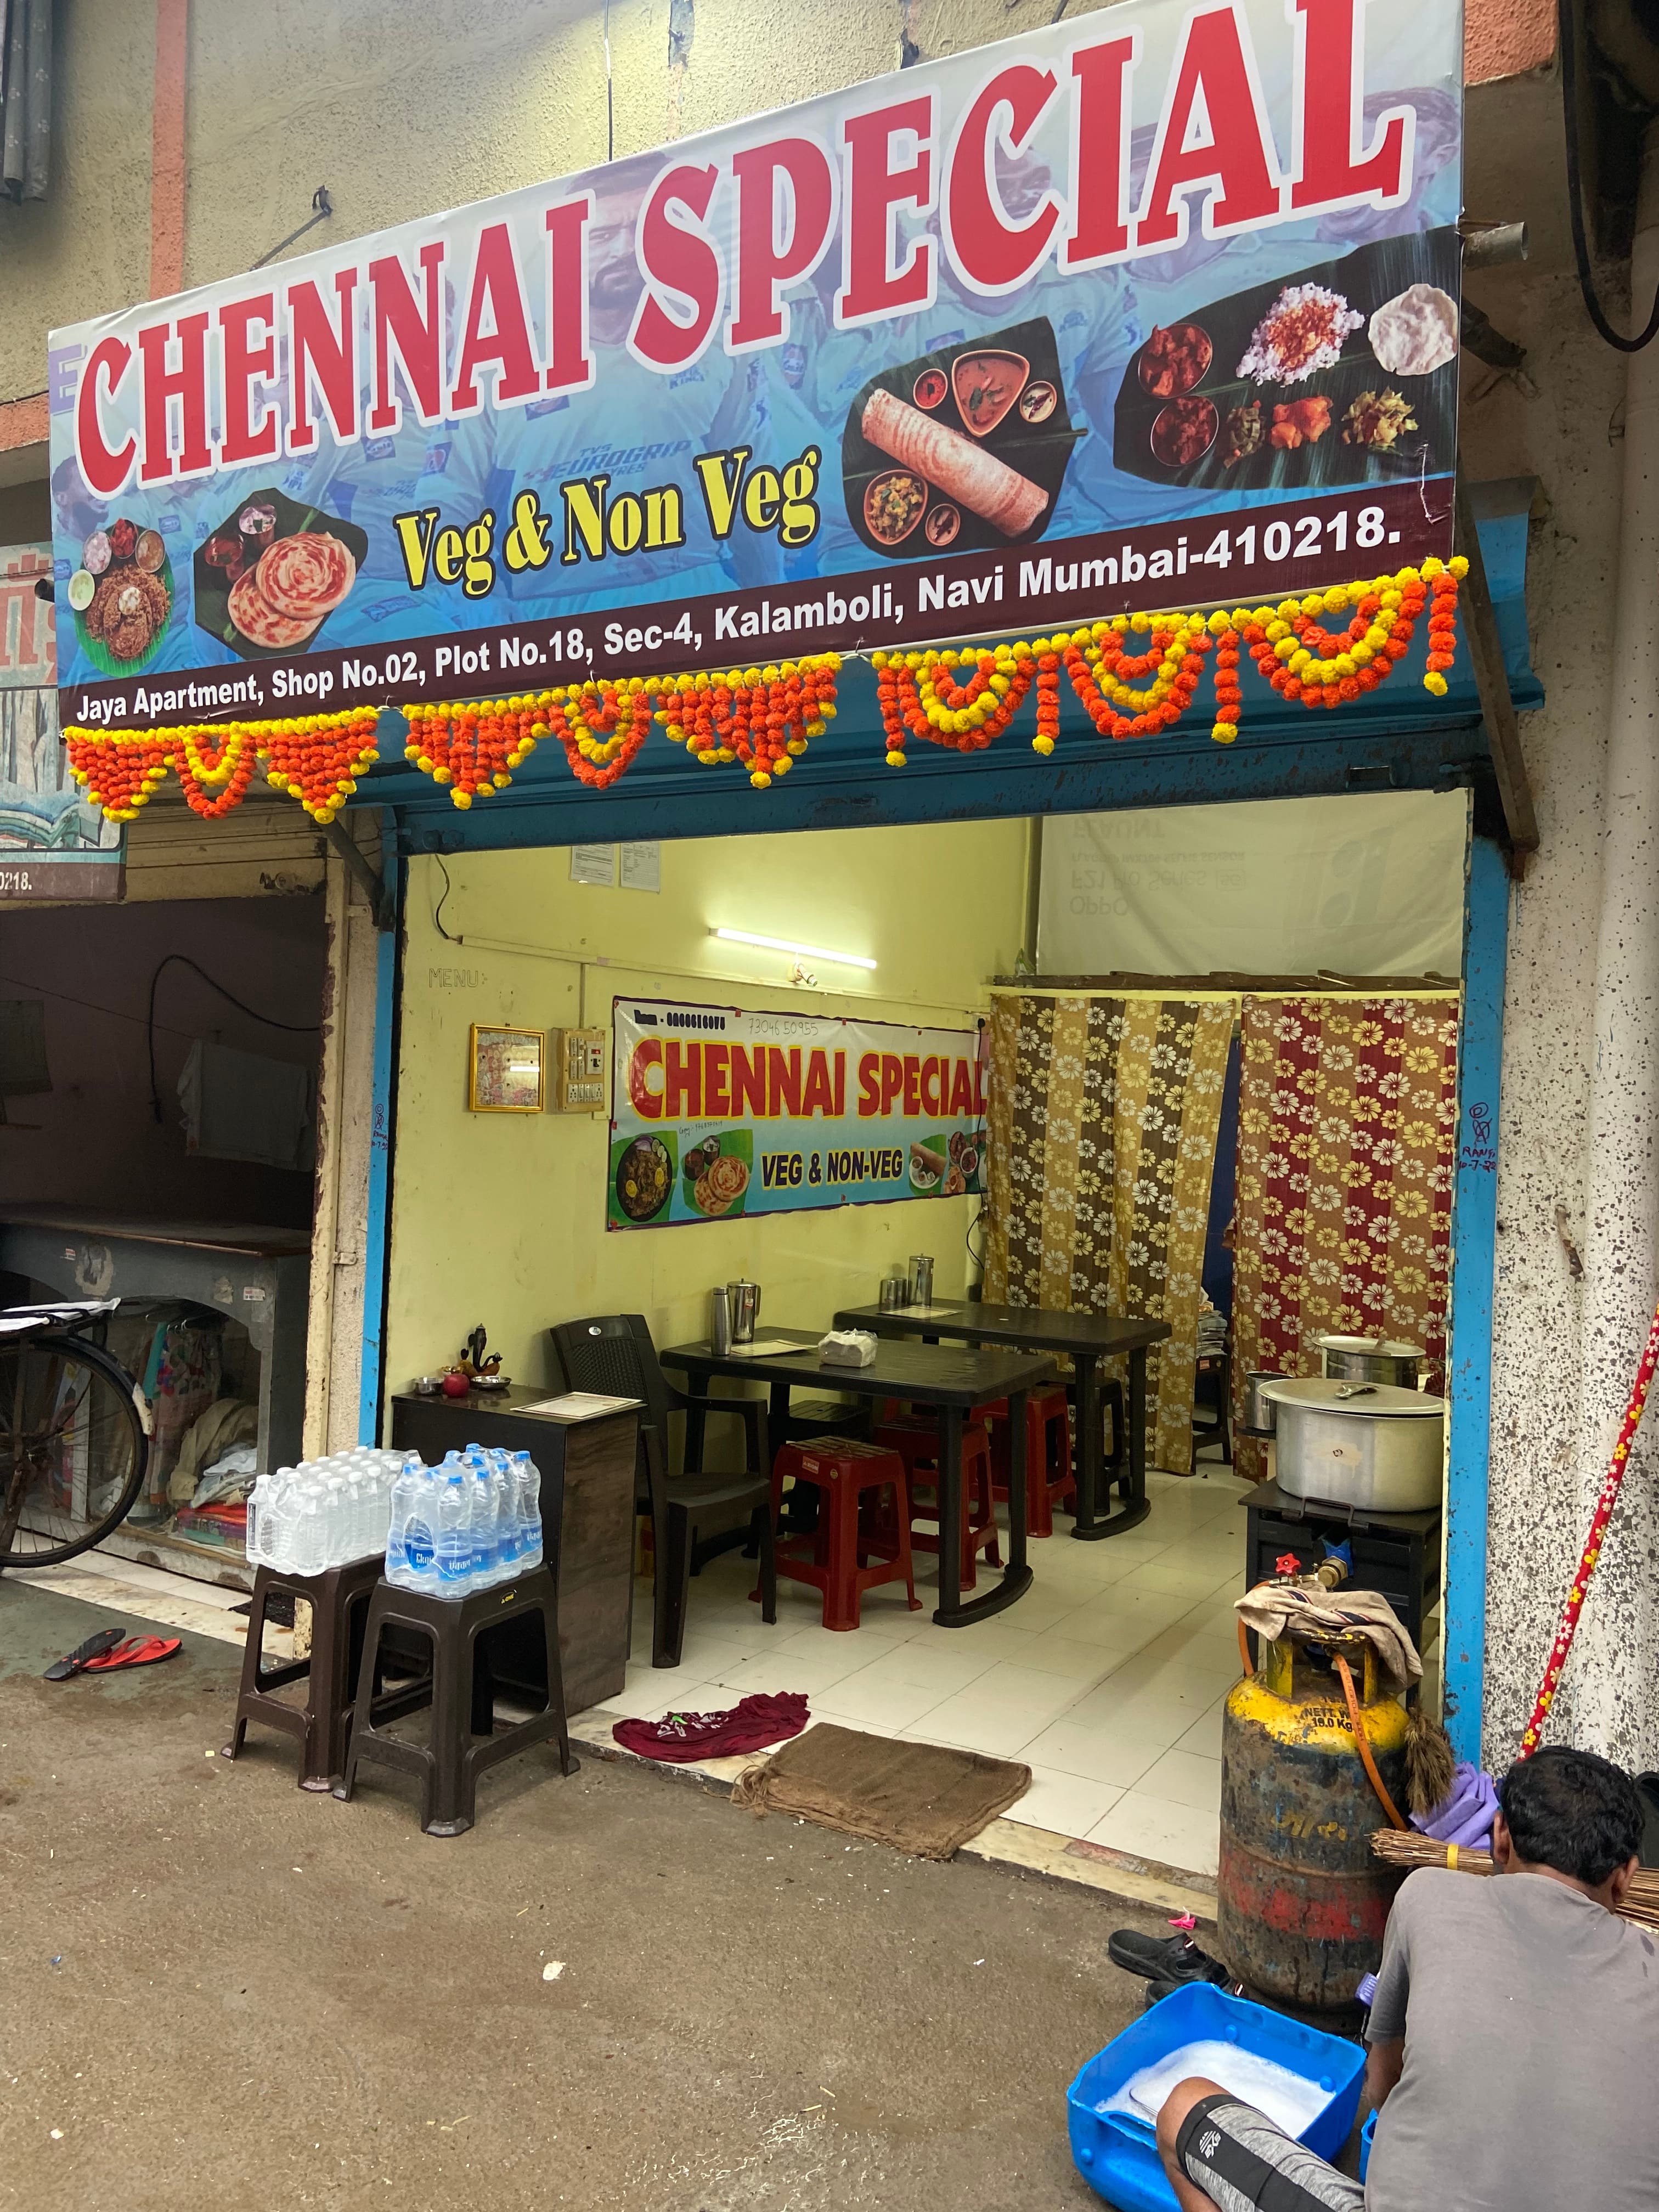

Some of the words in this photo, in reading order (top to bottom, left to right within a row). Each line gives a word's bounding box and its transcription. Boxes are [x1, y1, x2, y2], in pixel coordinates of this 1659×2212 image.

[74, 199, 591, 494] CHENNAI
[631, 0, 1406, 366] SPECIAL
[579, 443, 614, 457] TVS
[397, 512, 493, 595] Veg
[506, 492, 550, 571] &
[563, 478, 684, 562] Non
[696, 449, 818, 544] Veg
[77, 695, 126, 726] Jaya
[133, 674, 264, 719] Apartment,
[272, 668, 332, 699] Shop
[342, 652, 426, 688] No.02,
[435, 641, 489, 678] Plot
[500, 627, 594, 668] No.18,
[603, 612, 703, 655] Sec-4,
[715, 583, 905, 640] Kalamboli,
[918, 565, 1005, 613] Navi
[1018, 506, 1402, 598] Mumbai-410218.
[629, 1037, 847, 1119] CHENNAI
[857, 1052, 988, 1118] SPECIAL
[761, 1154, 802, 1187] VEG
[808, 1155, 822, 1184] &
[827, 1149, 904, 1182] NON-VEG
[1313, 1717, 1335, 1728] 19.0
[1337, 1718, 1353, 1733] Kg
